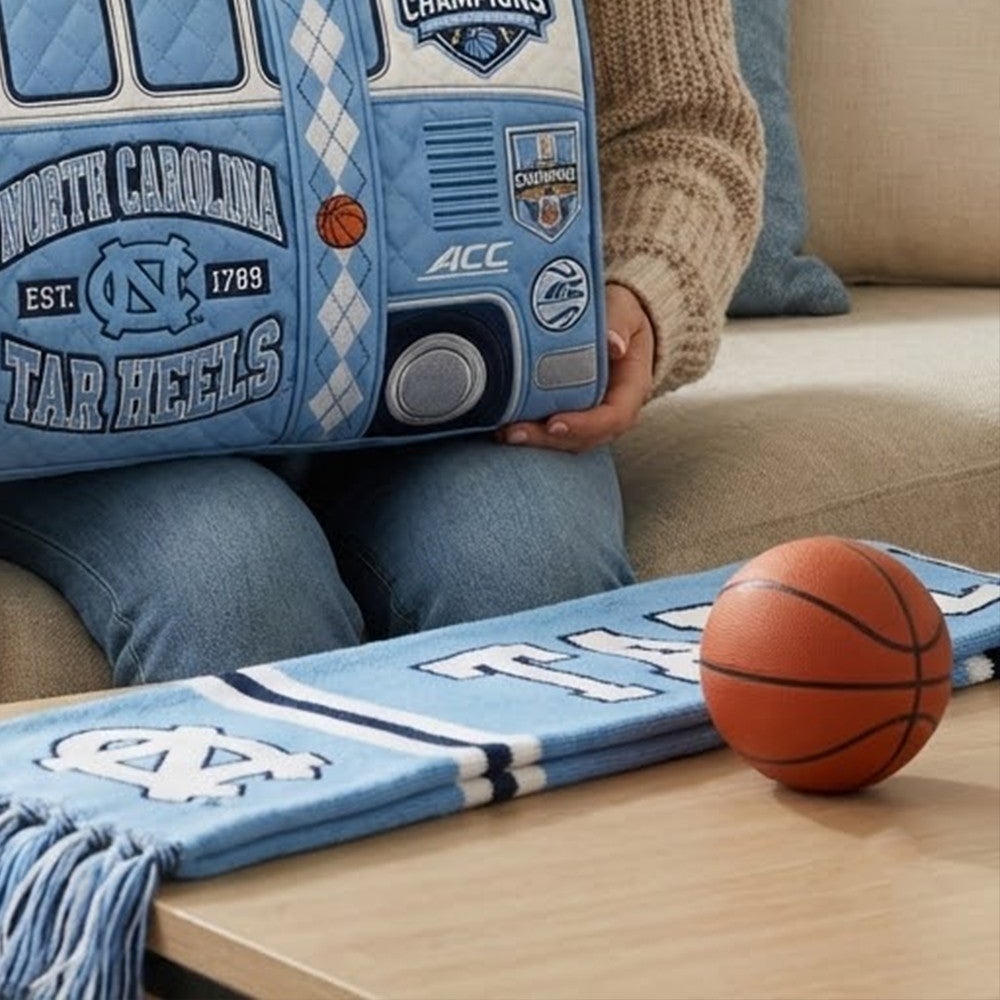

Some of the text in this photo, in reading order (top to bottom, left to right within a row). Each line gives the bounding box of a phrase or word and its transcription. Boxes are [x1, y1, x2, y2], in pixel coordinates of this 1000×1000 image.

[114, 145, 286, 243] CAROLINA
[25, 284, 75, 311] EST.
[425, 240, 513, 274] ACC
[3, 317, 284, 431] TAR HEELS
[409, 600, 715, 704] TA
